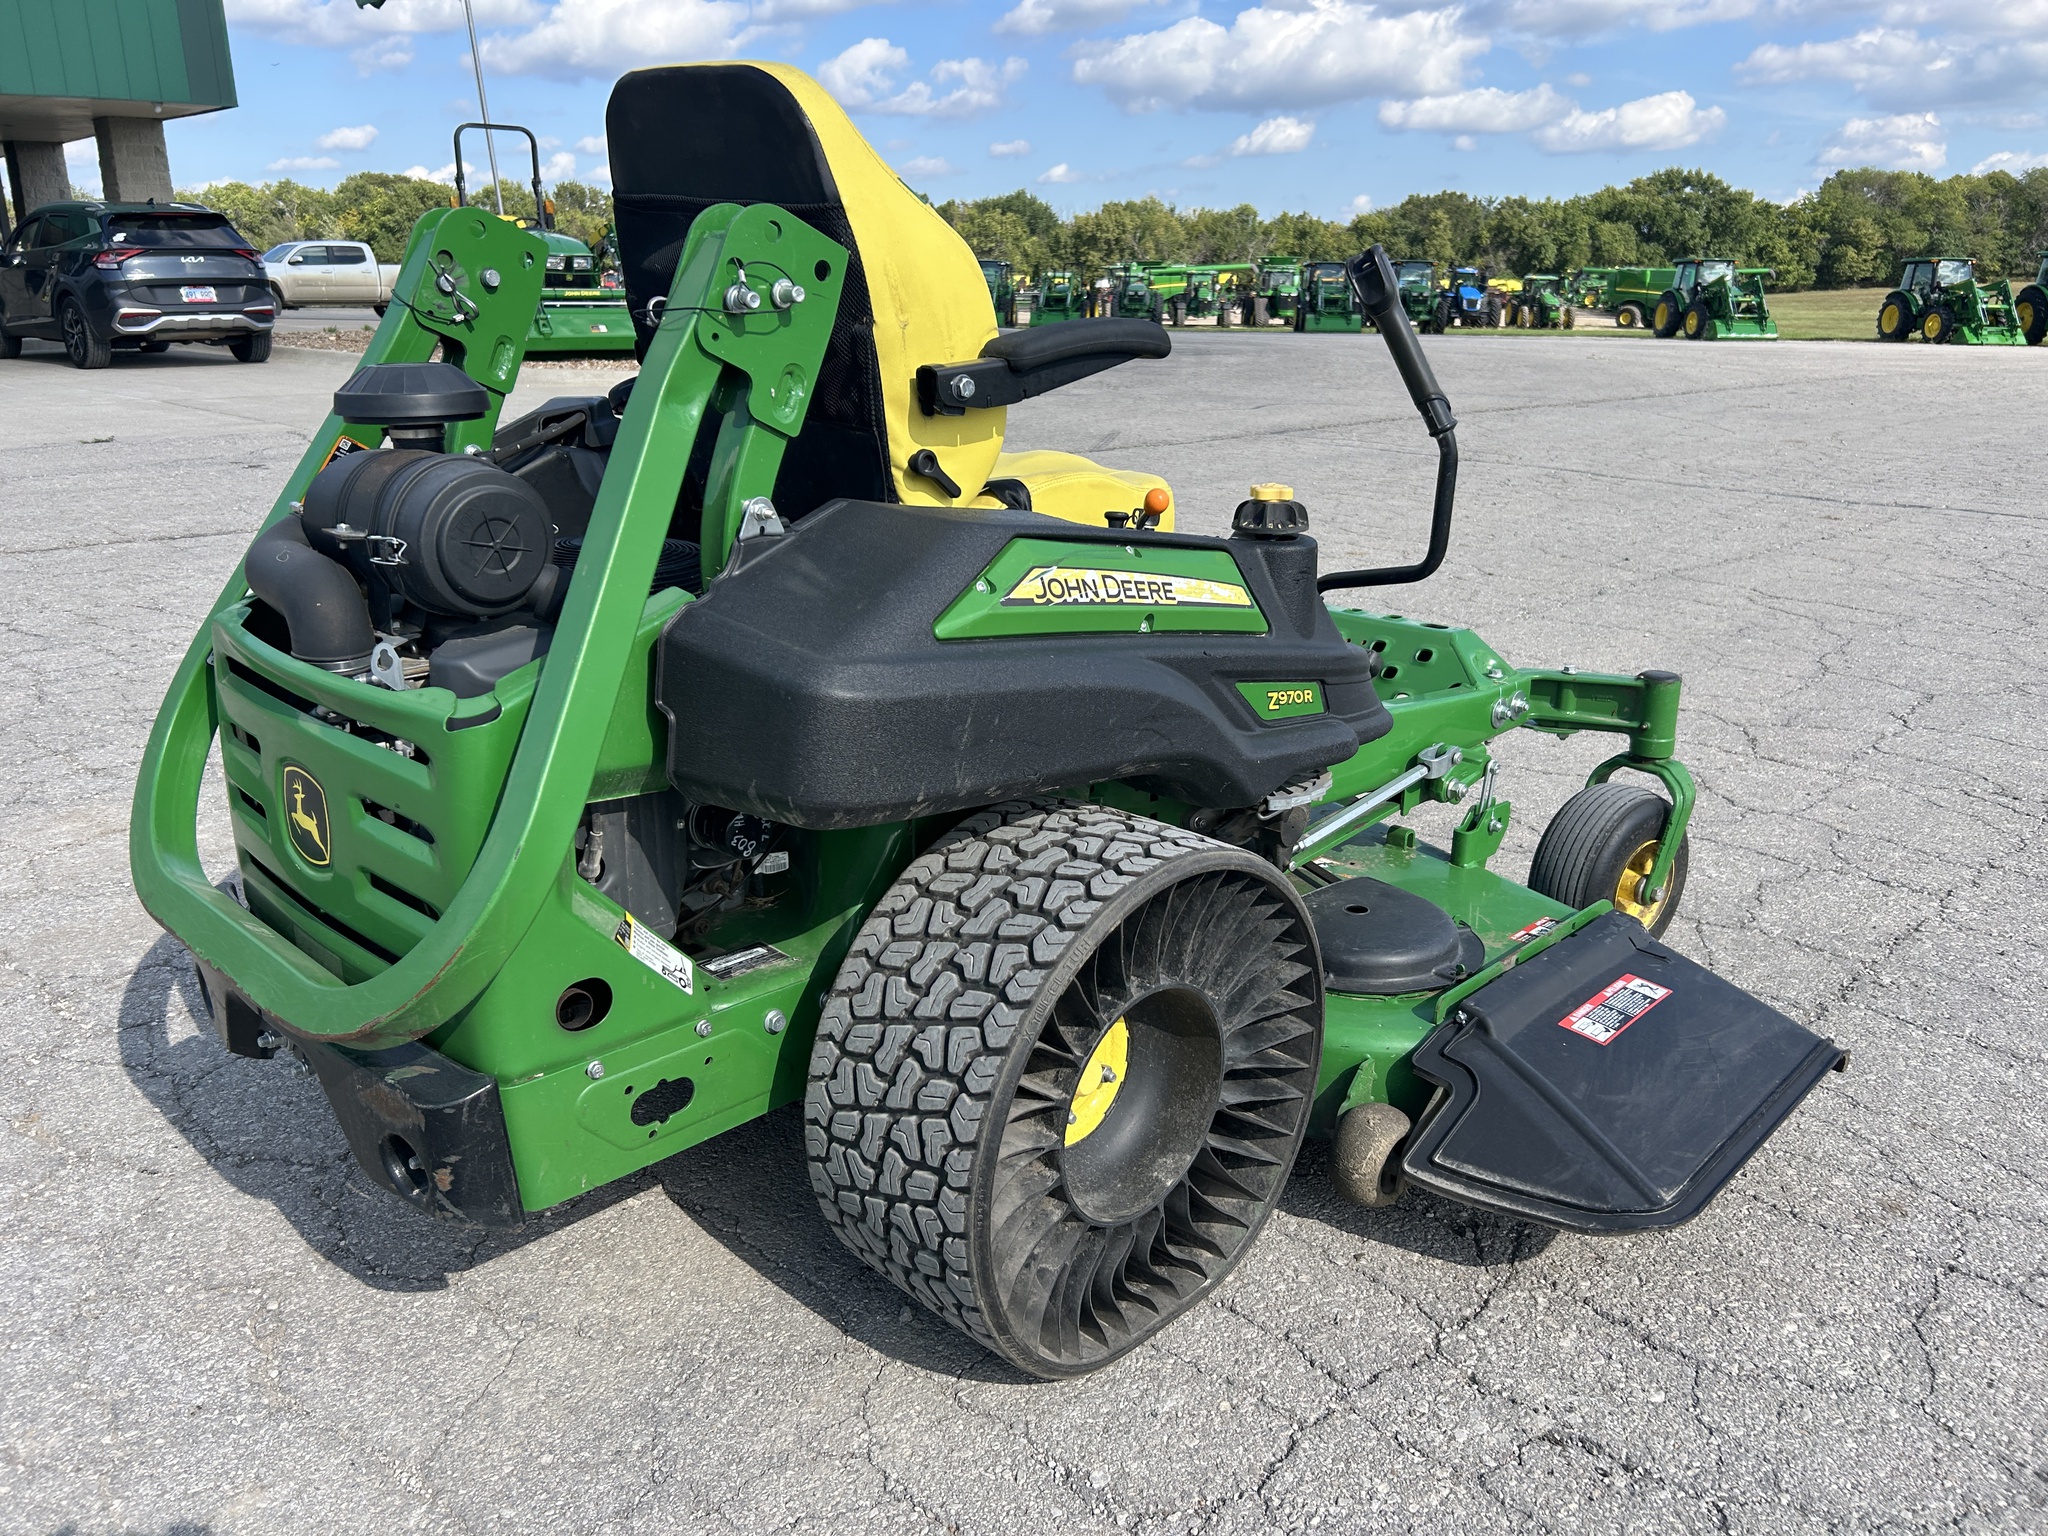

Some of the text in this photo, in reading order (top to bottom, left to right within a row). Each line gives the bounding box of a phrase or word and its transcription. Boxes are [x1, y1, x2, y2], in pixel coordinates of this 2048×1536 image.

[1035, 574, 1177, 601] JOHN DEERE
[1266, 689, 1314, 711] Z970R
